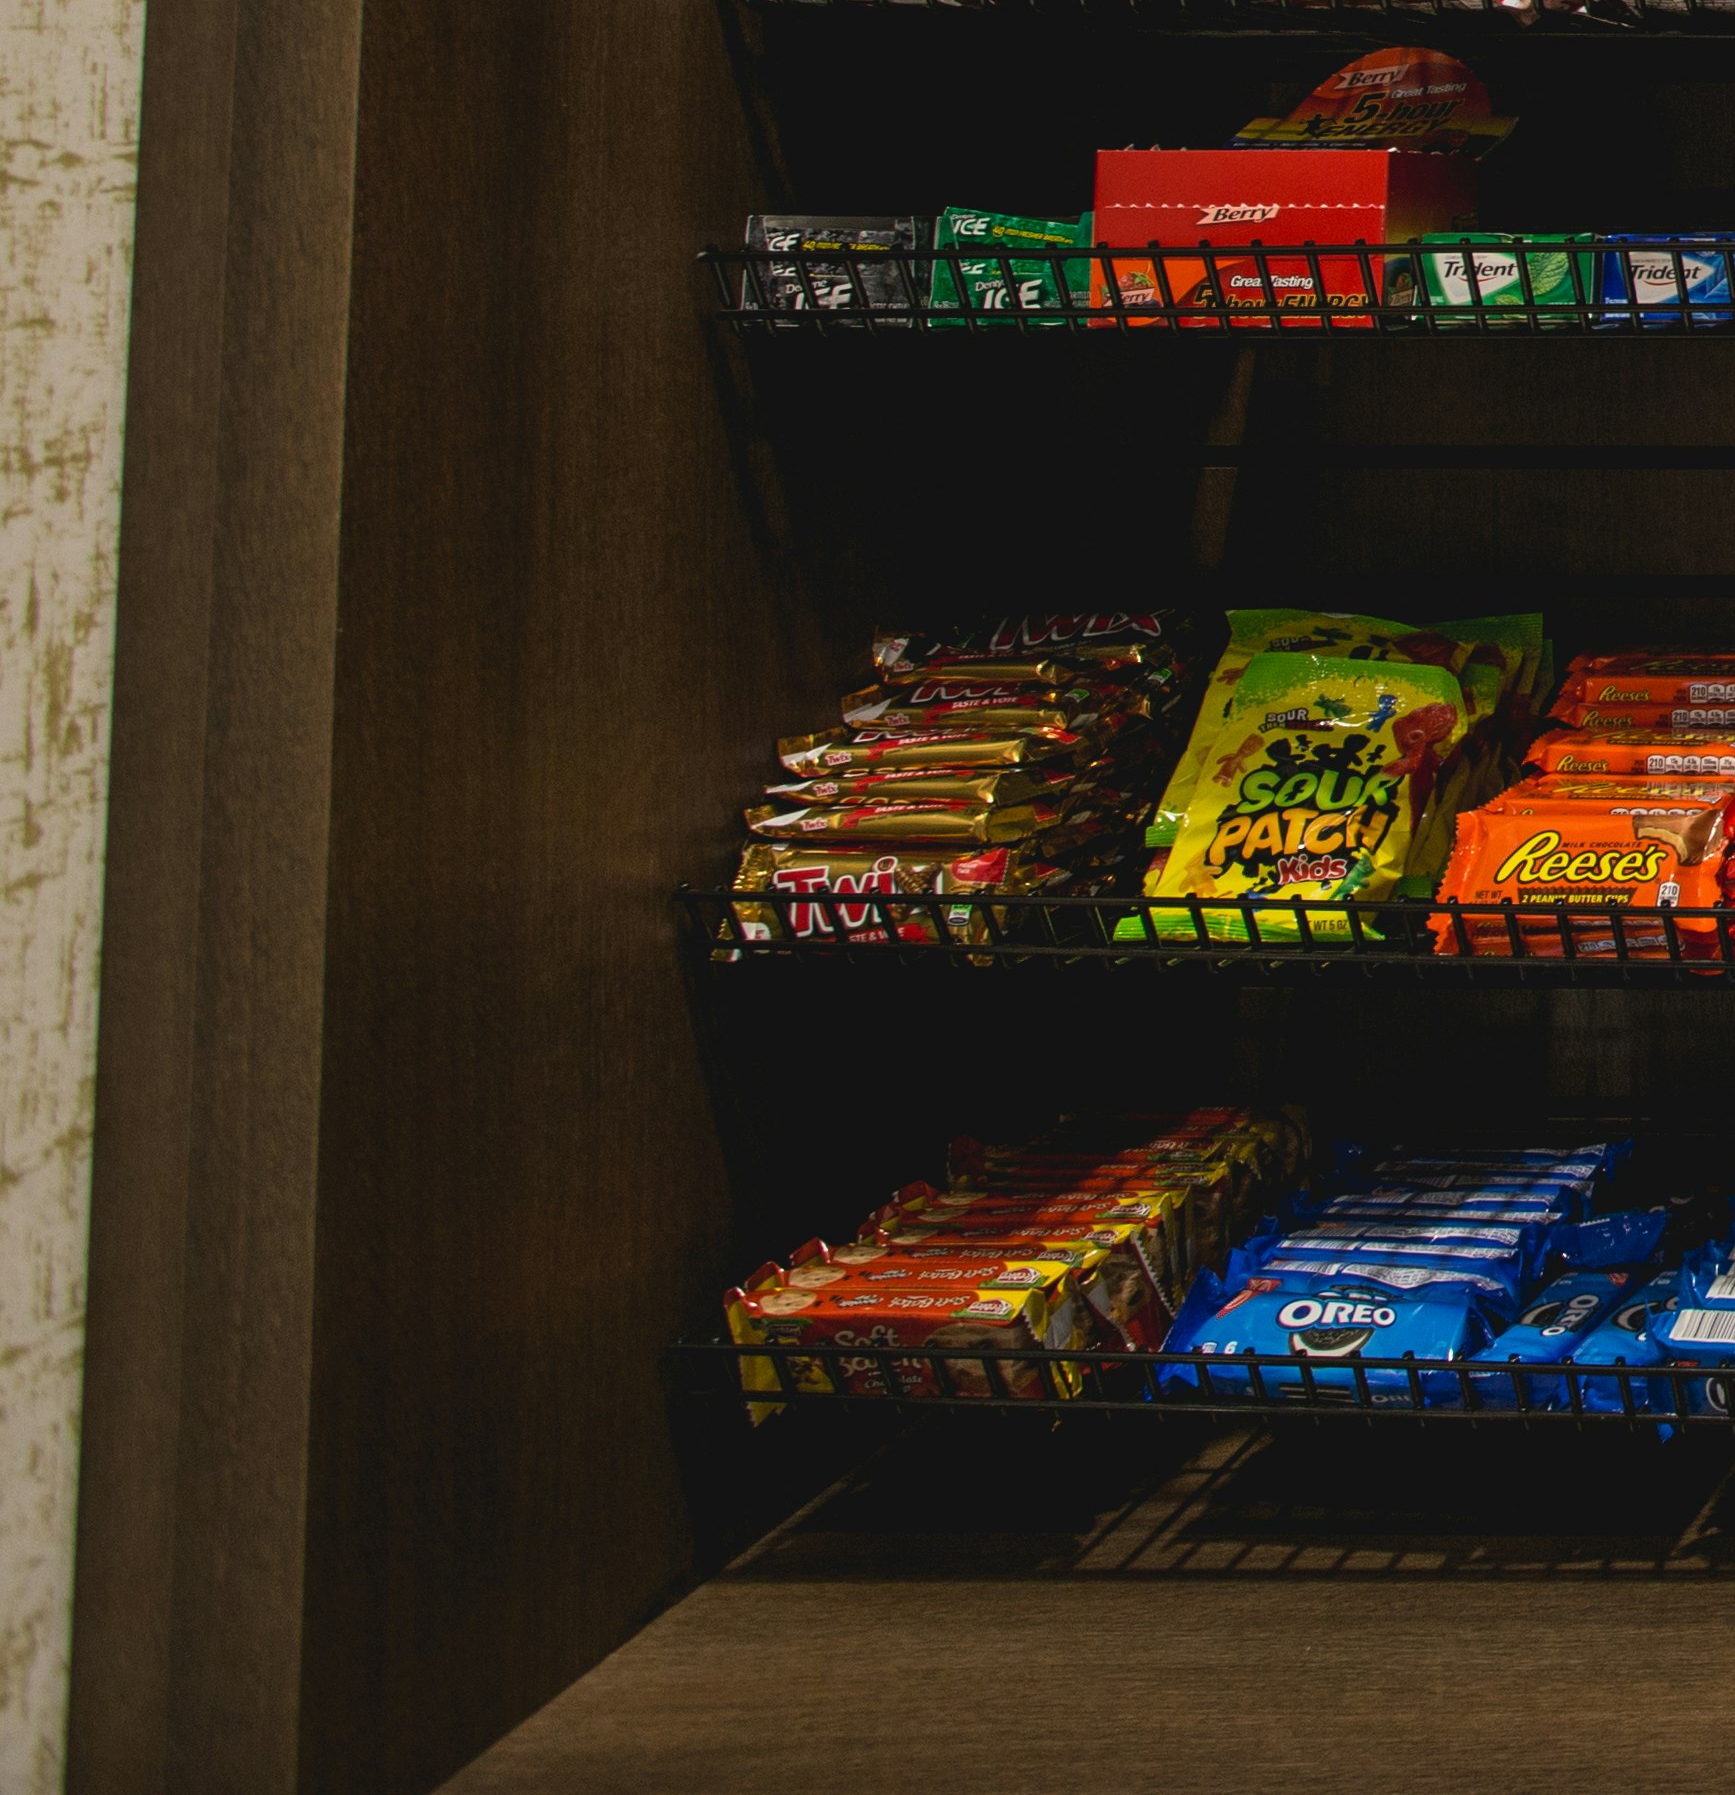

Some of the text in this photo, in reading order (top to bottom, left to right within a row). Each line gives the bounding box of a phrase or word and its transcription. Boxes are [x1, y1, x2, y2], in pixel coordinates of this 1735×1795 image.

[1347, 67, 1401, 87] Berry
[1391, 81, 1467, 100] Great Tasting
[1212, 205, 1273, 224] Berry
[953, 217, 992, 235] ICE
[1599, 685, 1650, 702] Reese's
[1267, 708, 1308, 724] SOUR
[1583, 712, 1632, 728] Reese's
[1557, 755, 1608, 773] Reese's
[1237, 768, 1401, 815] SOUR
[1206, 806, 1389, 866] PATCH
[1495, 830, 1668, 884] Reese's
[1277, 855, 1348, 886] Kids
[1278, 1298, 1396, 1328] OREO
